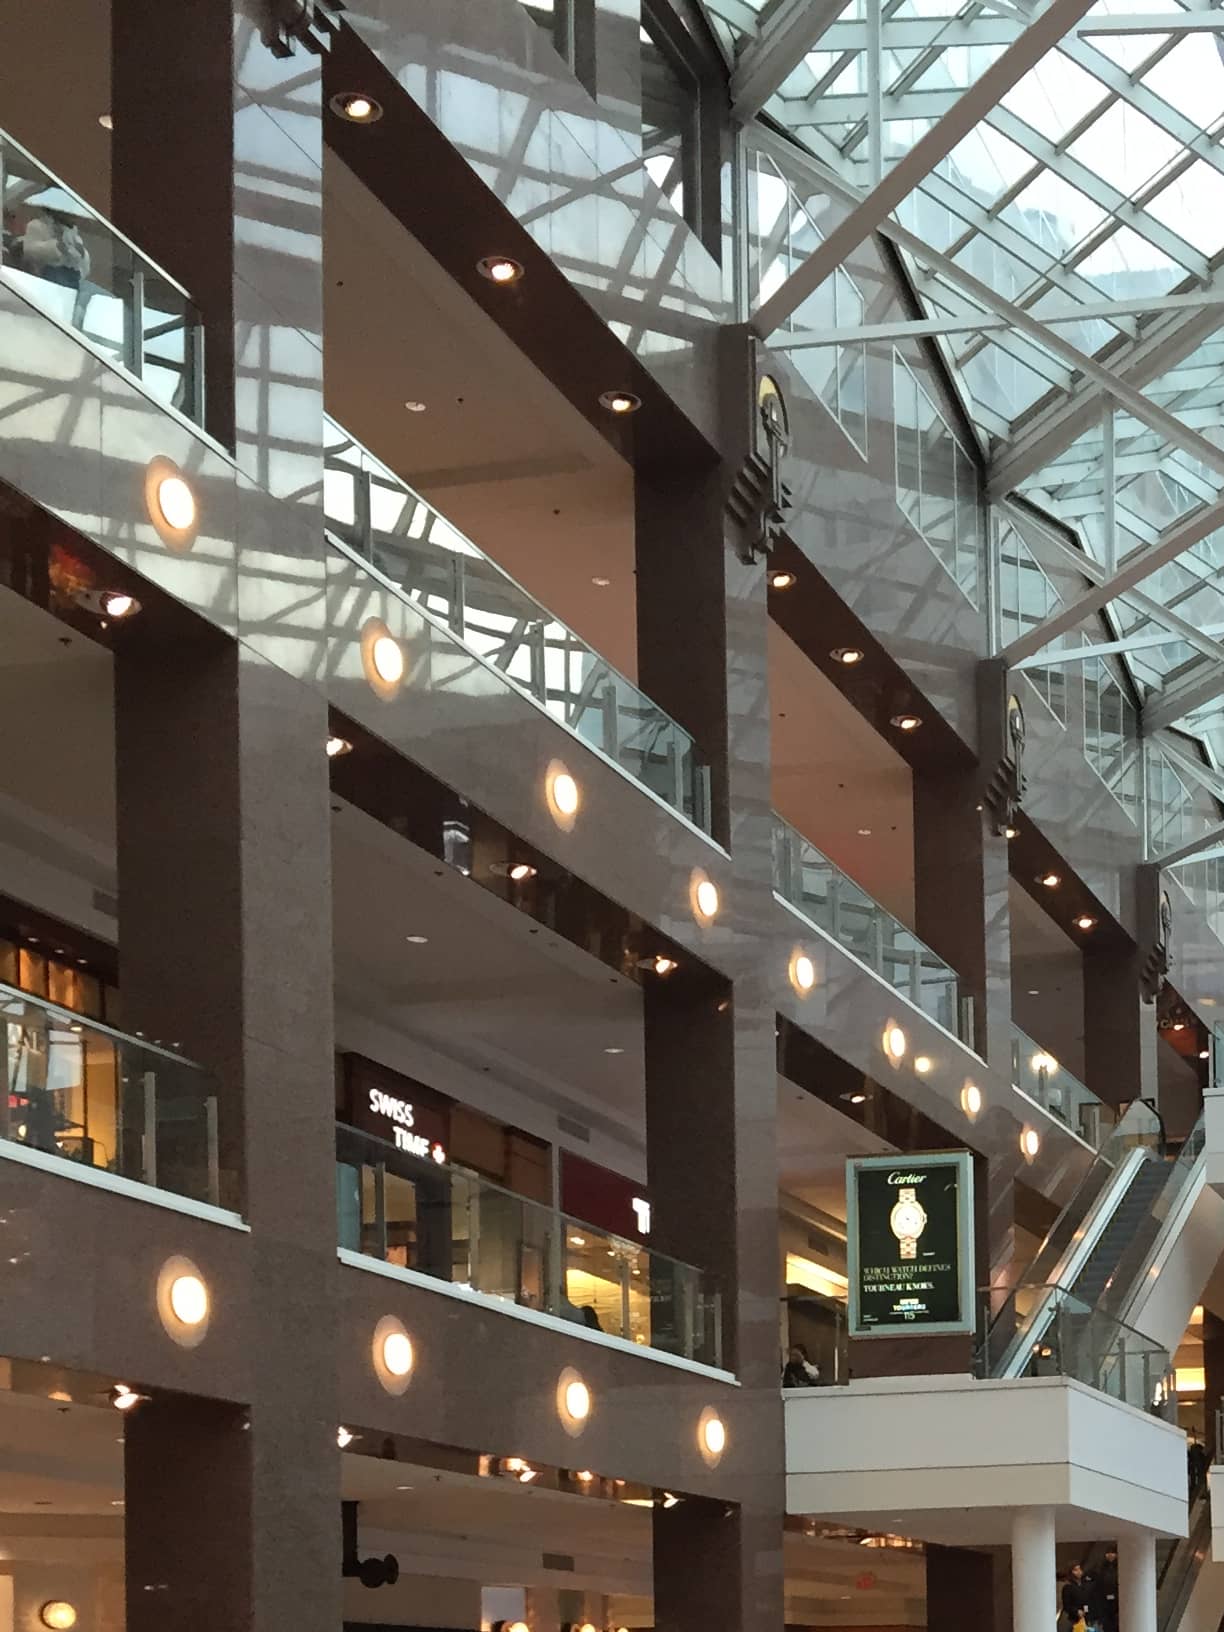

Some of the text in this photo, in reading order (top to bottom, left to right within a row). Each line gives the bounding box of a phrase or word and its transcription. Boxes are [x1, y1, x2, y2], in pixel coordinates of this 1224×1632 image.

[369, 1088, 414, 1127] SWISS
[392, 1126, 430, 1157] TIME
[887, 1171, 927, 1185] Cartier
